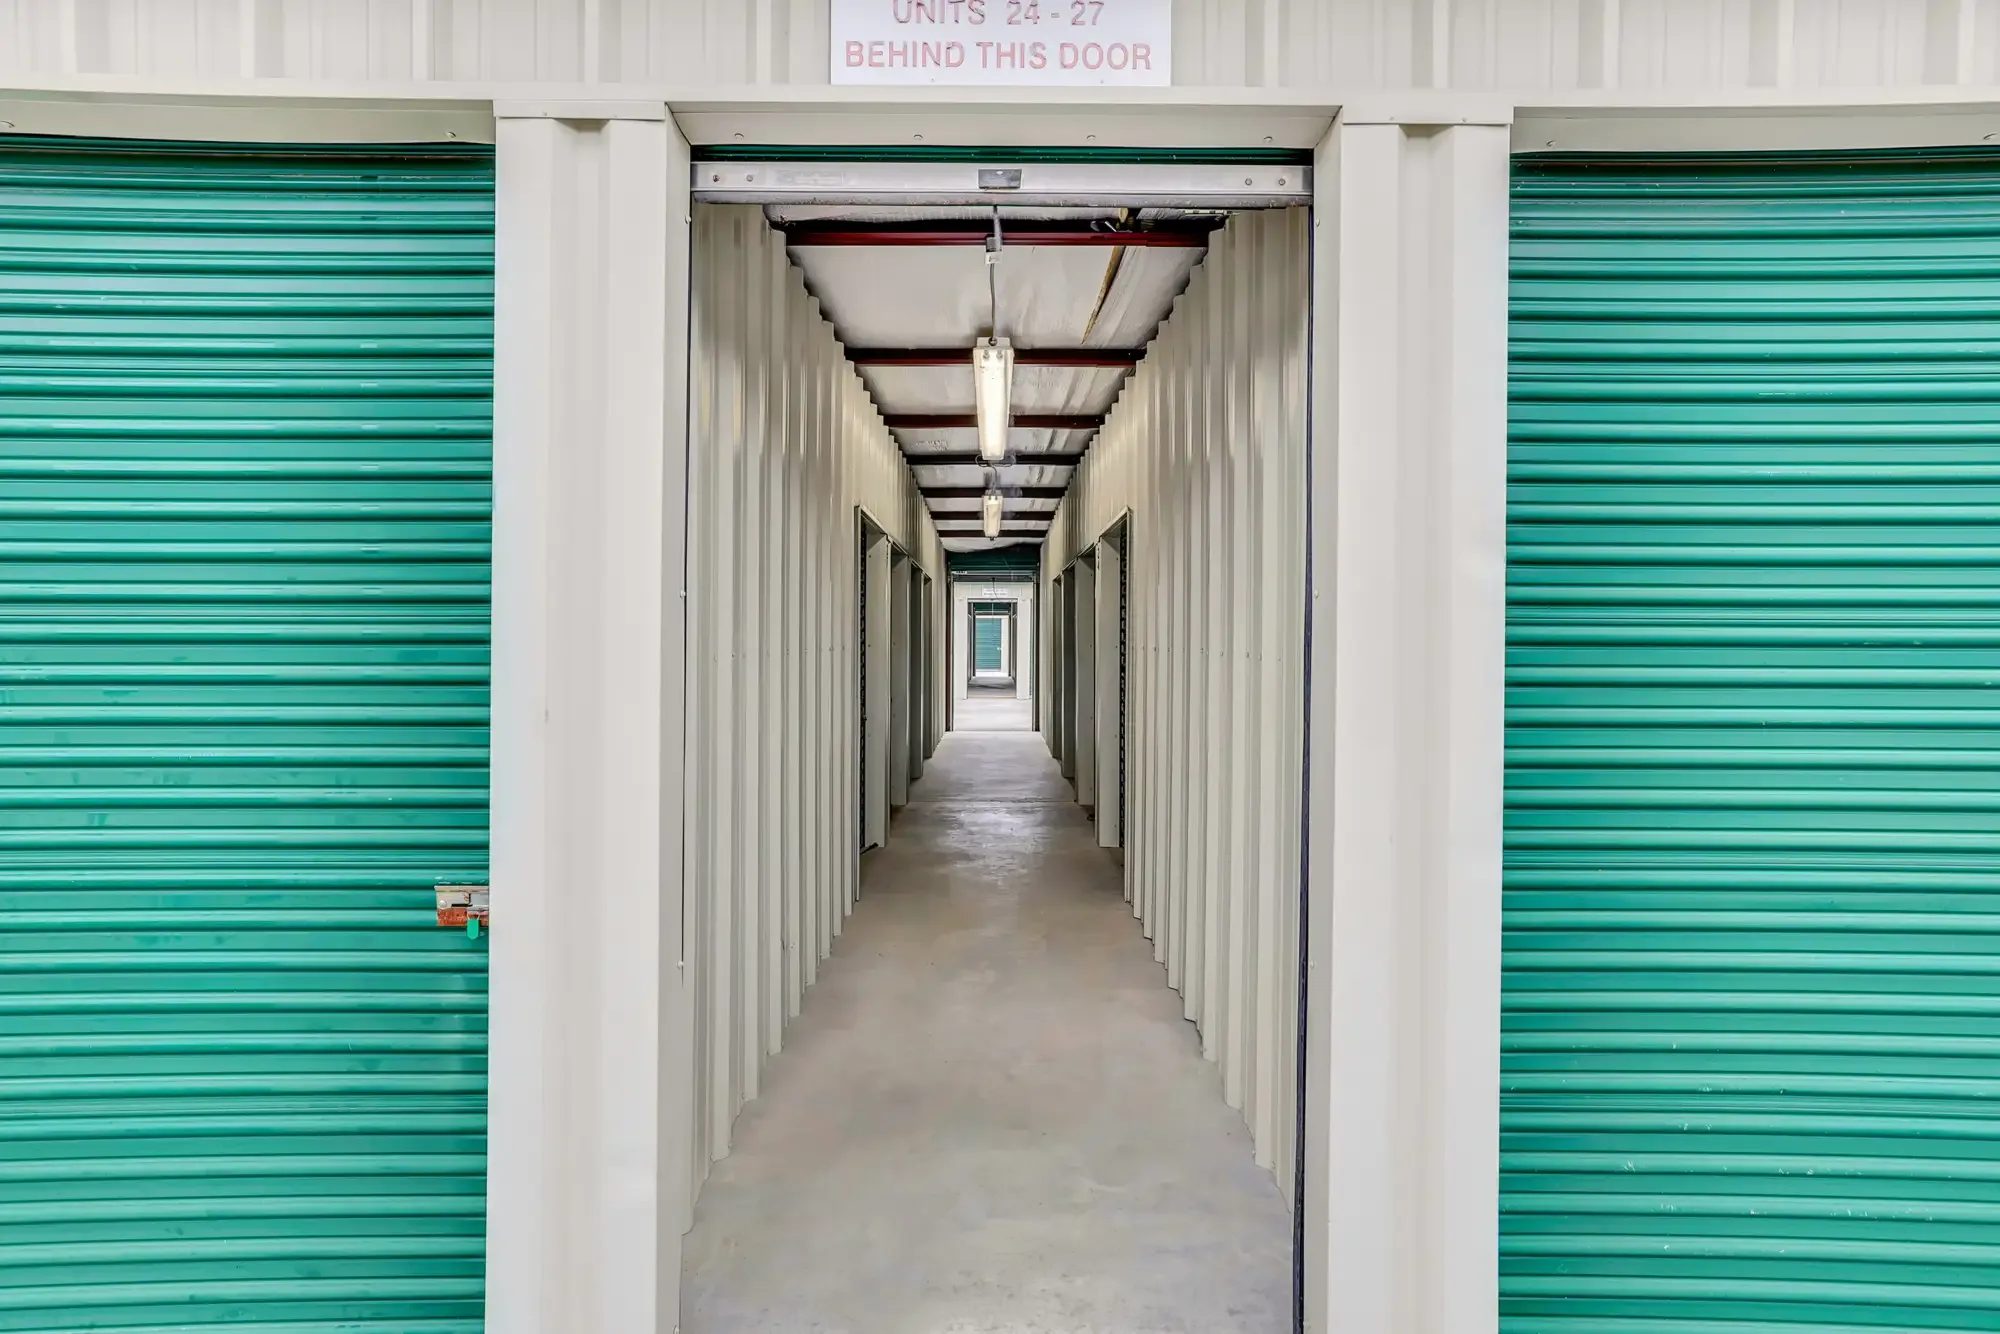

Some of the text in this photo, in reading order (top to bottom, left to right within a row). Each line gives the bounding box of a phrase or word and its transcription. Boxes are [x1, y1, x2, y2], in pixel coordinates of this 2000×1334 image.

[892, 0, 986, 24] UNITS
[1006, 0, 1040, 25] 24
[1071, 1, 1104, 26] 27
[845, 41, 1151, 70] BEHIND THIS DOOR
